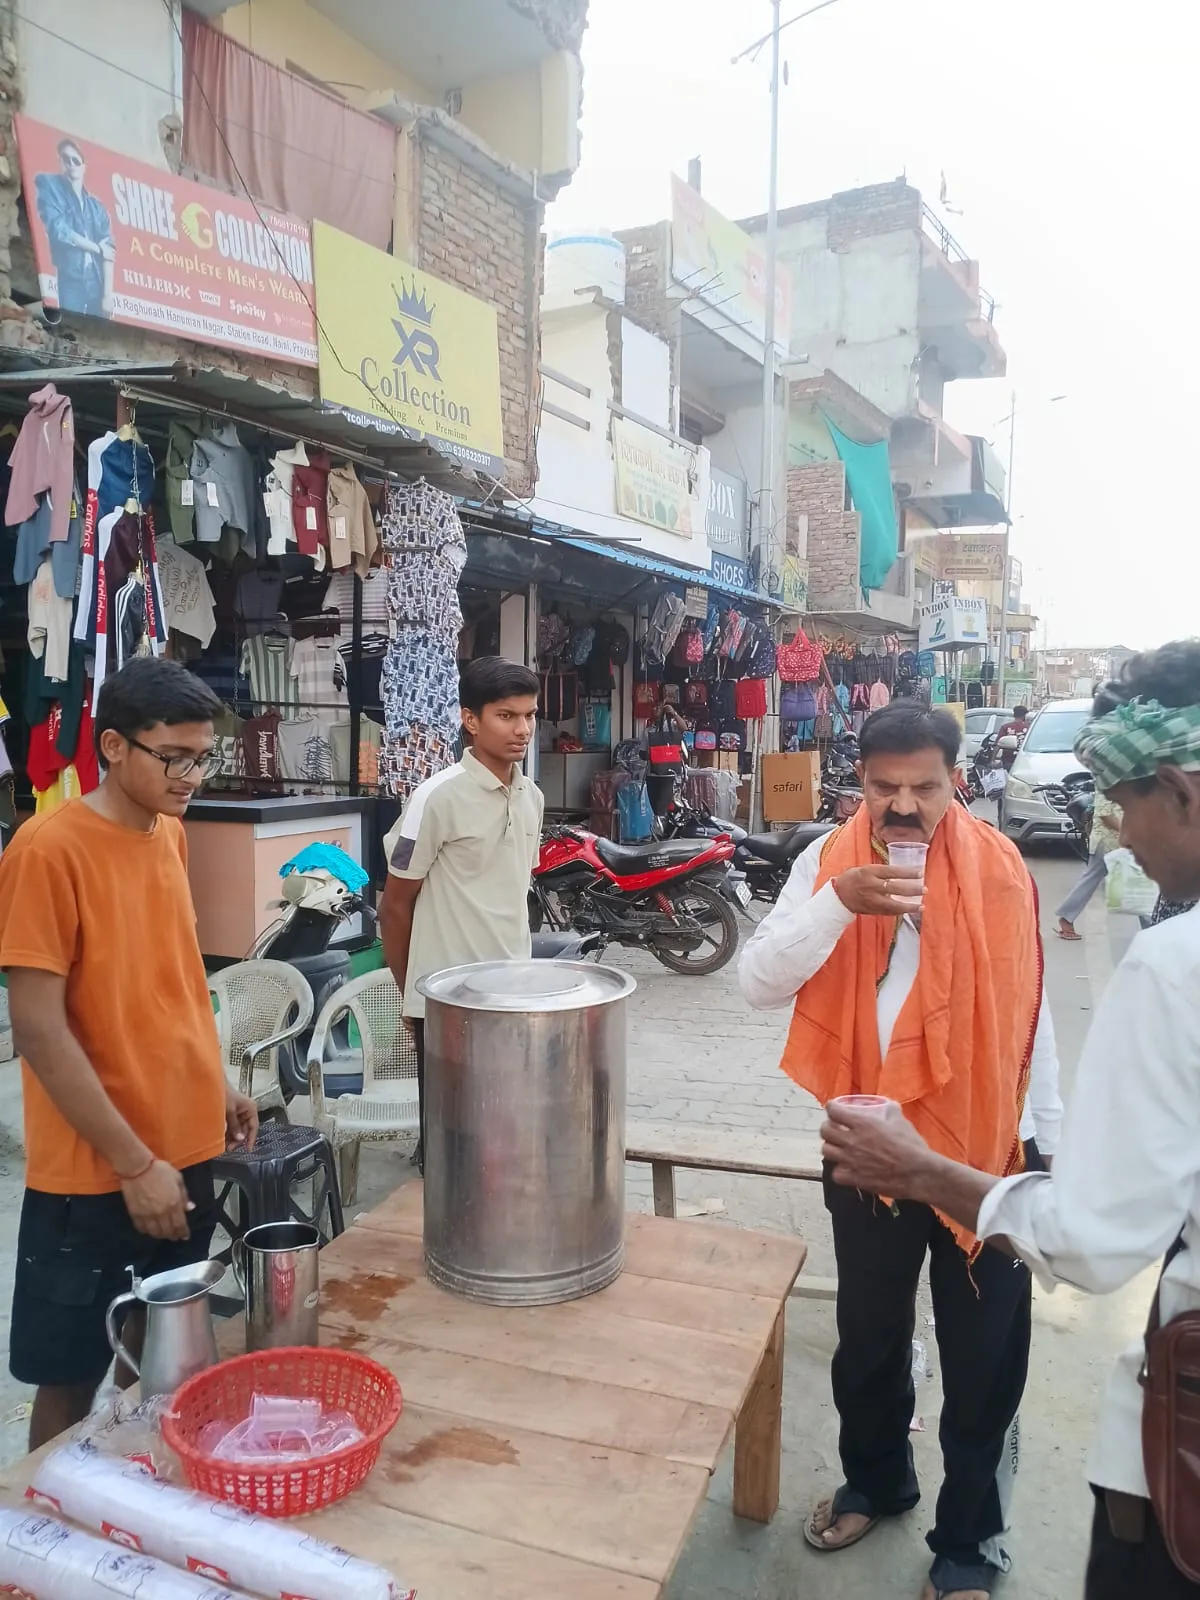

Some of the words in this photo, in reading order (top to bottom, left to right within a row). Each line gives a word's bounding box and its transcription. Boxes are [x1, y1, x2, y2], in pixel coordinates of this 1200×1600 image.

[111, 173, 179, 242] SHREE
[214, 210, 313, 285] COLLECTION
[130, 236, 144, 257] A
[122, 299, 165, 319] Raghunath
[390, 317, 443, 382] XR
[360, 357, 472, 427] Collection
[369, 397, 407, 423] Trending
[417, 415, 425, 426] &
[435, 421, 468, 441] Premium
[712, 560, 744, 588] SHOES
[921, 600, 950, 617] INBOX
[954, 598, 984, 610] INBOX
[772, 780, 803, 793] safari
